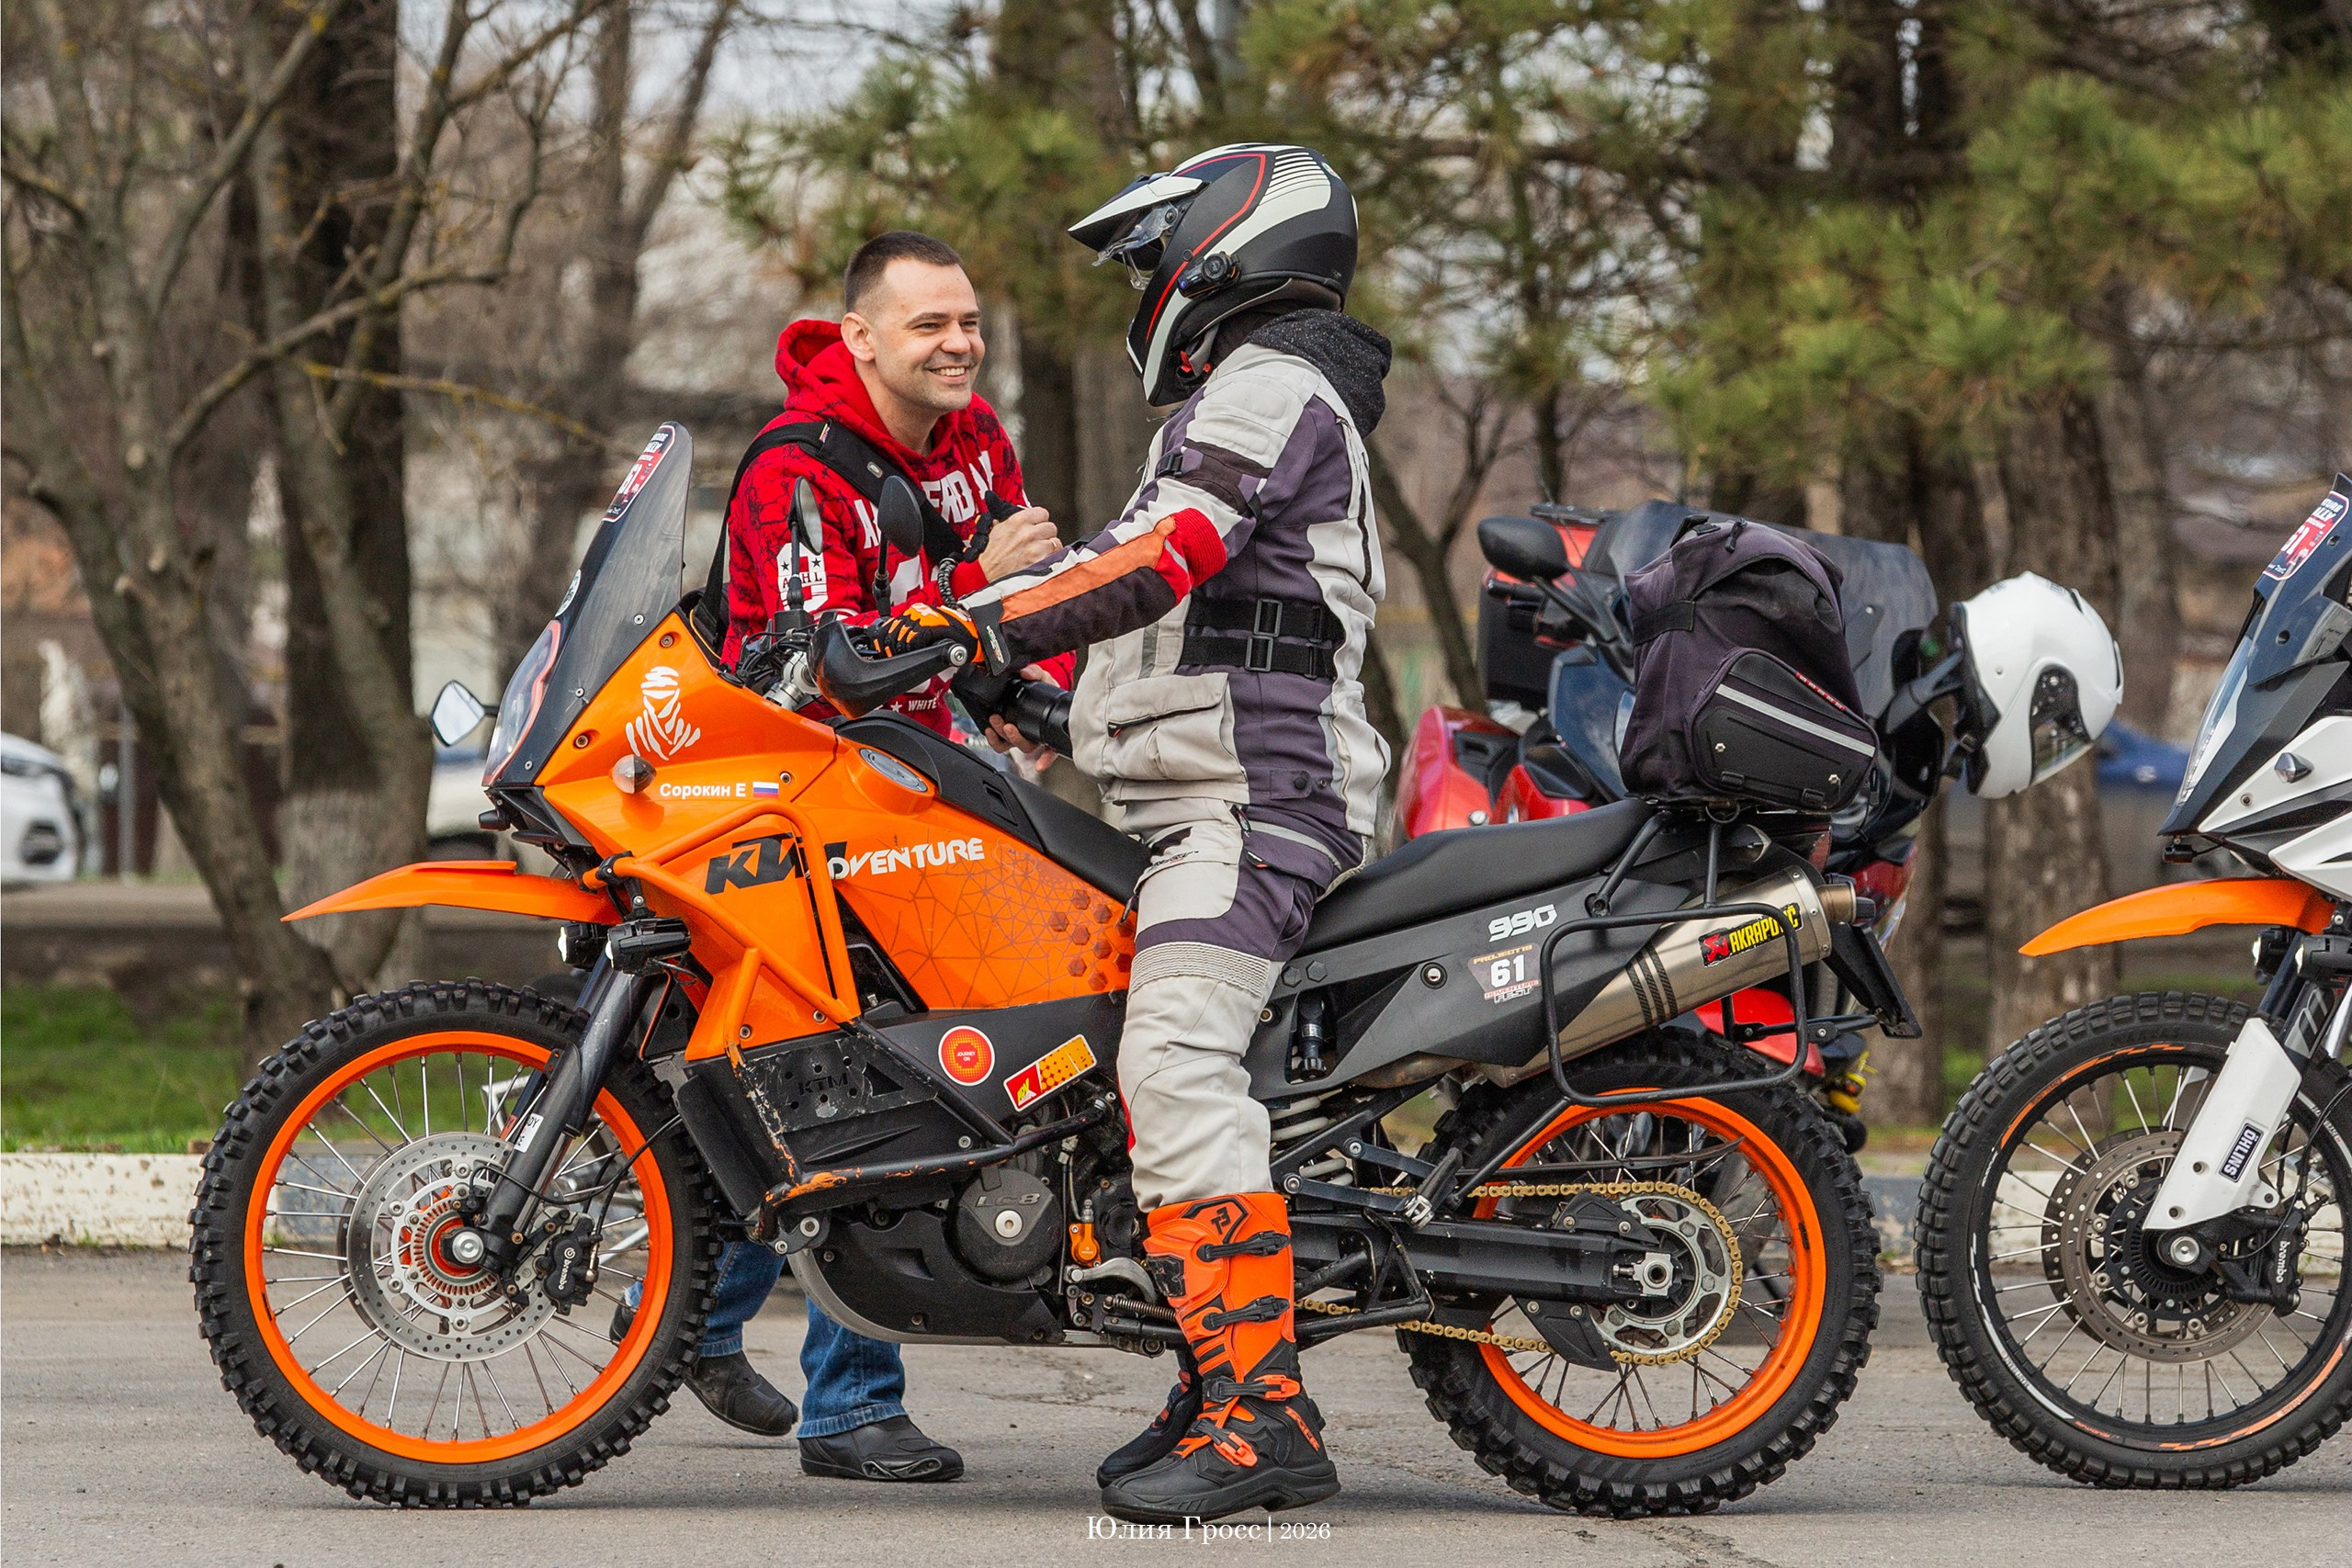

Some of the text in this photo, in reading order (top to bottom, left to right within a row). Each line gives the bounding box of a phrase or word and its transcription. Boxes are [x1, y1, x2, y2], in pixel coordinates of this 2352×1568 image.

[908, 696, 938, 712] WHITE
[659, 783, 746, 800] Сорокин Е
[805, 837, 986, 879] DVENTURE
[1488, 904, 1558, 942] 990
[1490, 953, 1525, 988] 61
[975, 1192, 1040, 1208] LC8
[558, 1258, 572, 1291] brembo
[2275, 1240, 2291, 1284] brembo
